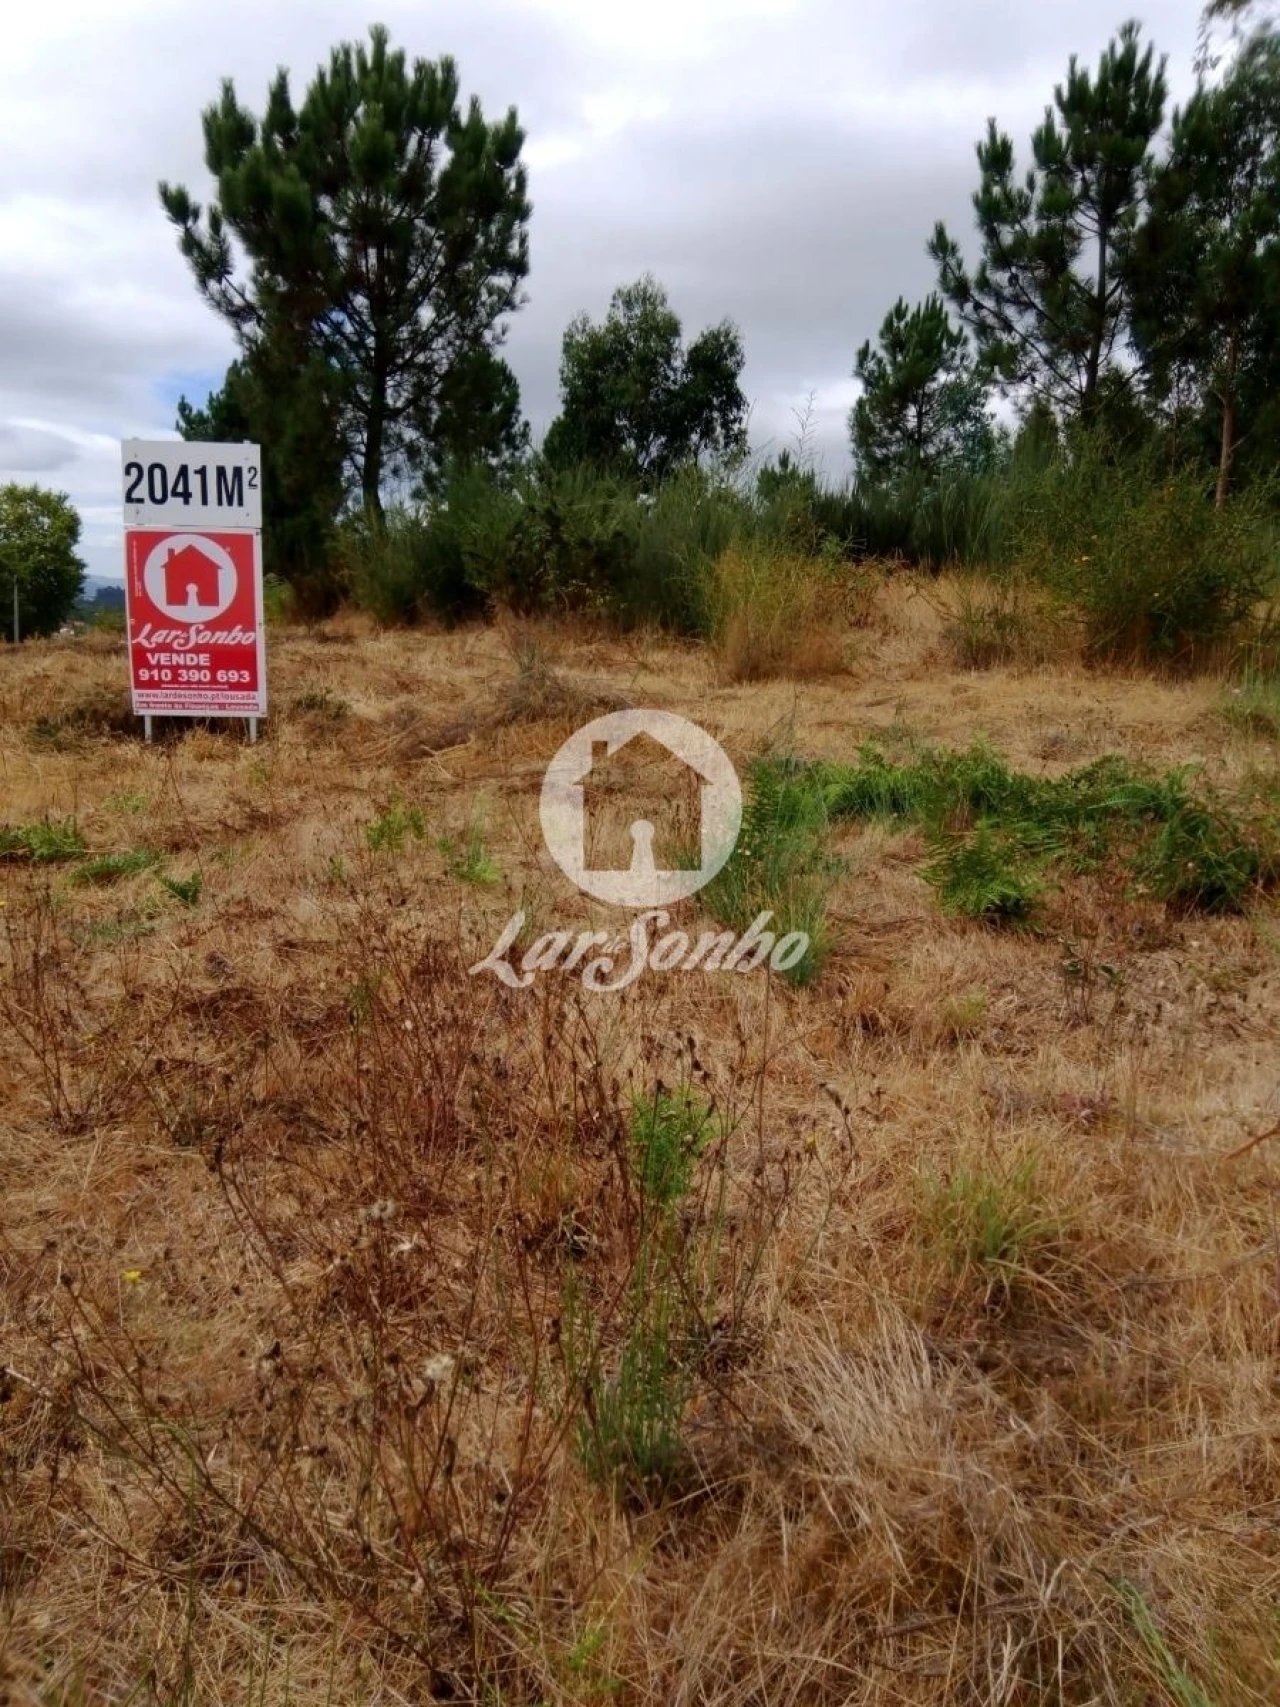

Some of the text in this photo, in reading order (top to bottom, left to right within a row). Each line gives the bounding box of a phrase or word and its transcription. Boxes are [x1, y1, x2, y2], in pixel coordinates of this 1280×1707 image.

[145, 653, 211, 666] VENDE
[138, 669, 250, 683] 910 390 693
